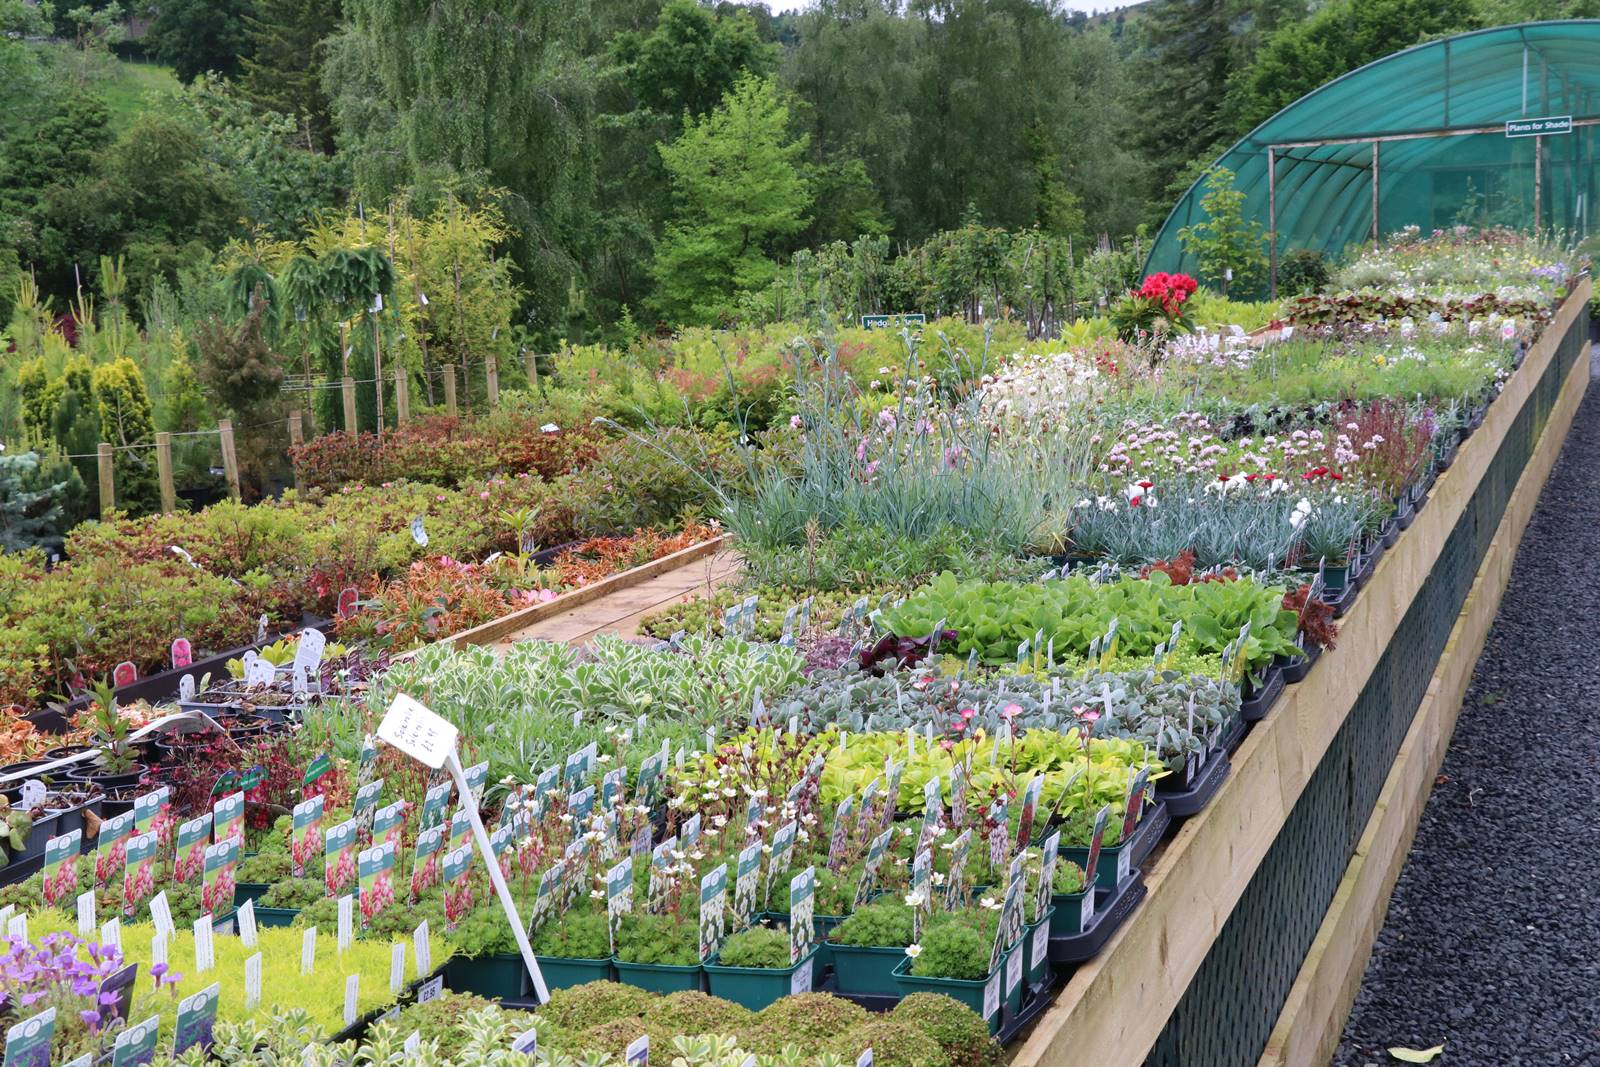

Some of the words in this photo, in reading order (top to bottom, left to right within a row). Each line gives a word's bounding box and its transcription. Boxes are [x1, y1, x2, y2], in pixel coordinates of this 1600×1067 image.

[1509, 124, 1531, 132] Plants
[1532, 122, 1543, 130] for
[1545, 121, 1569, 129] Shade
